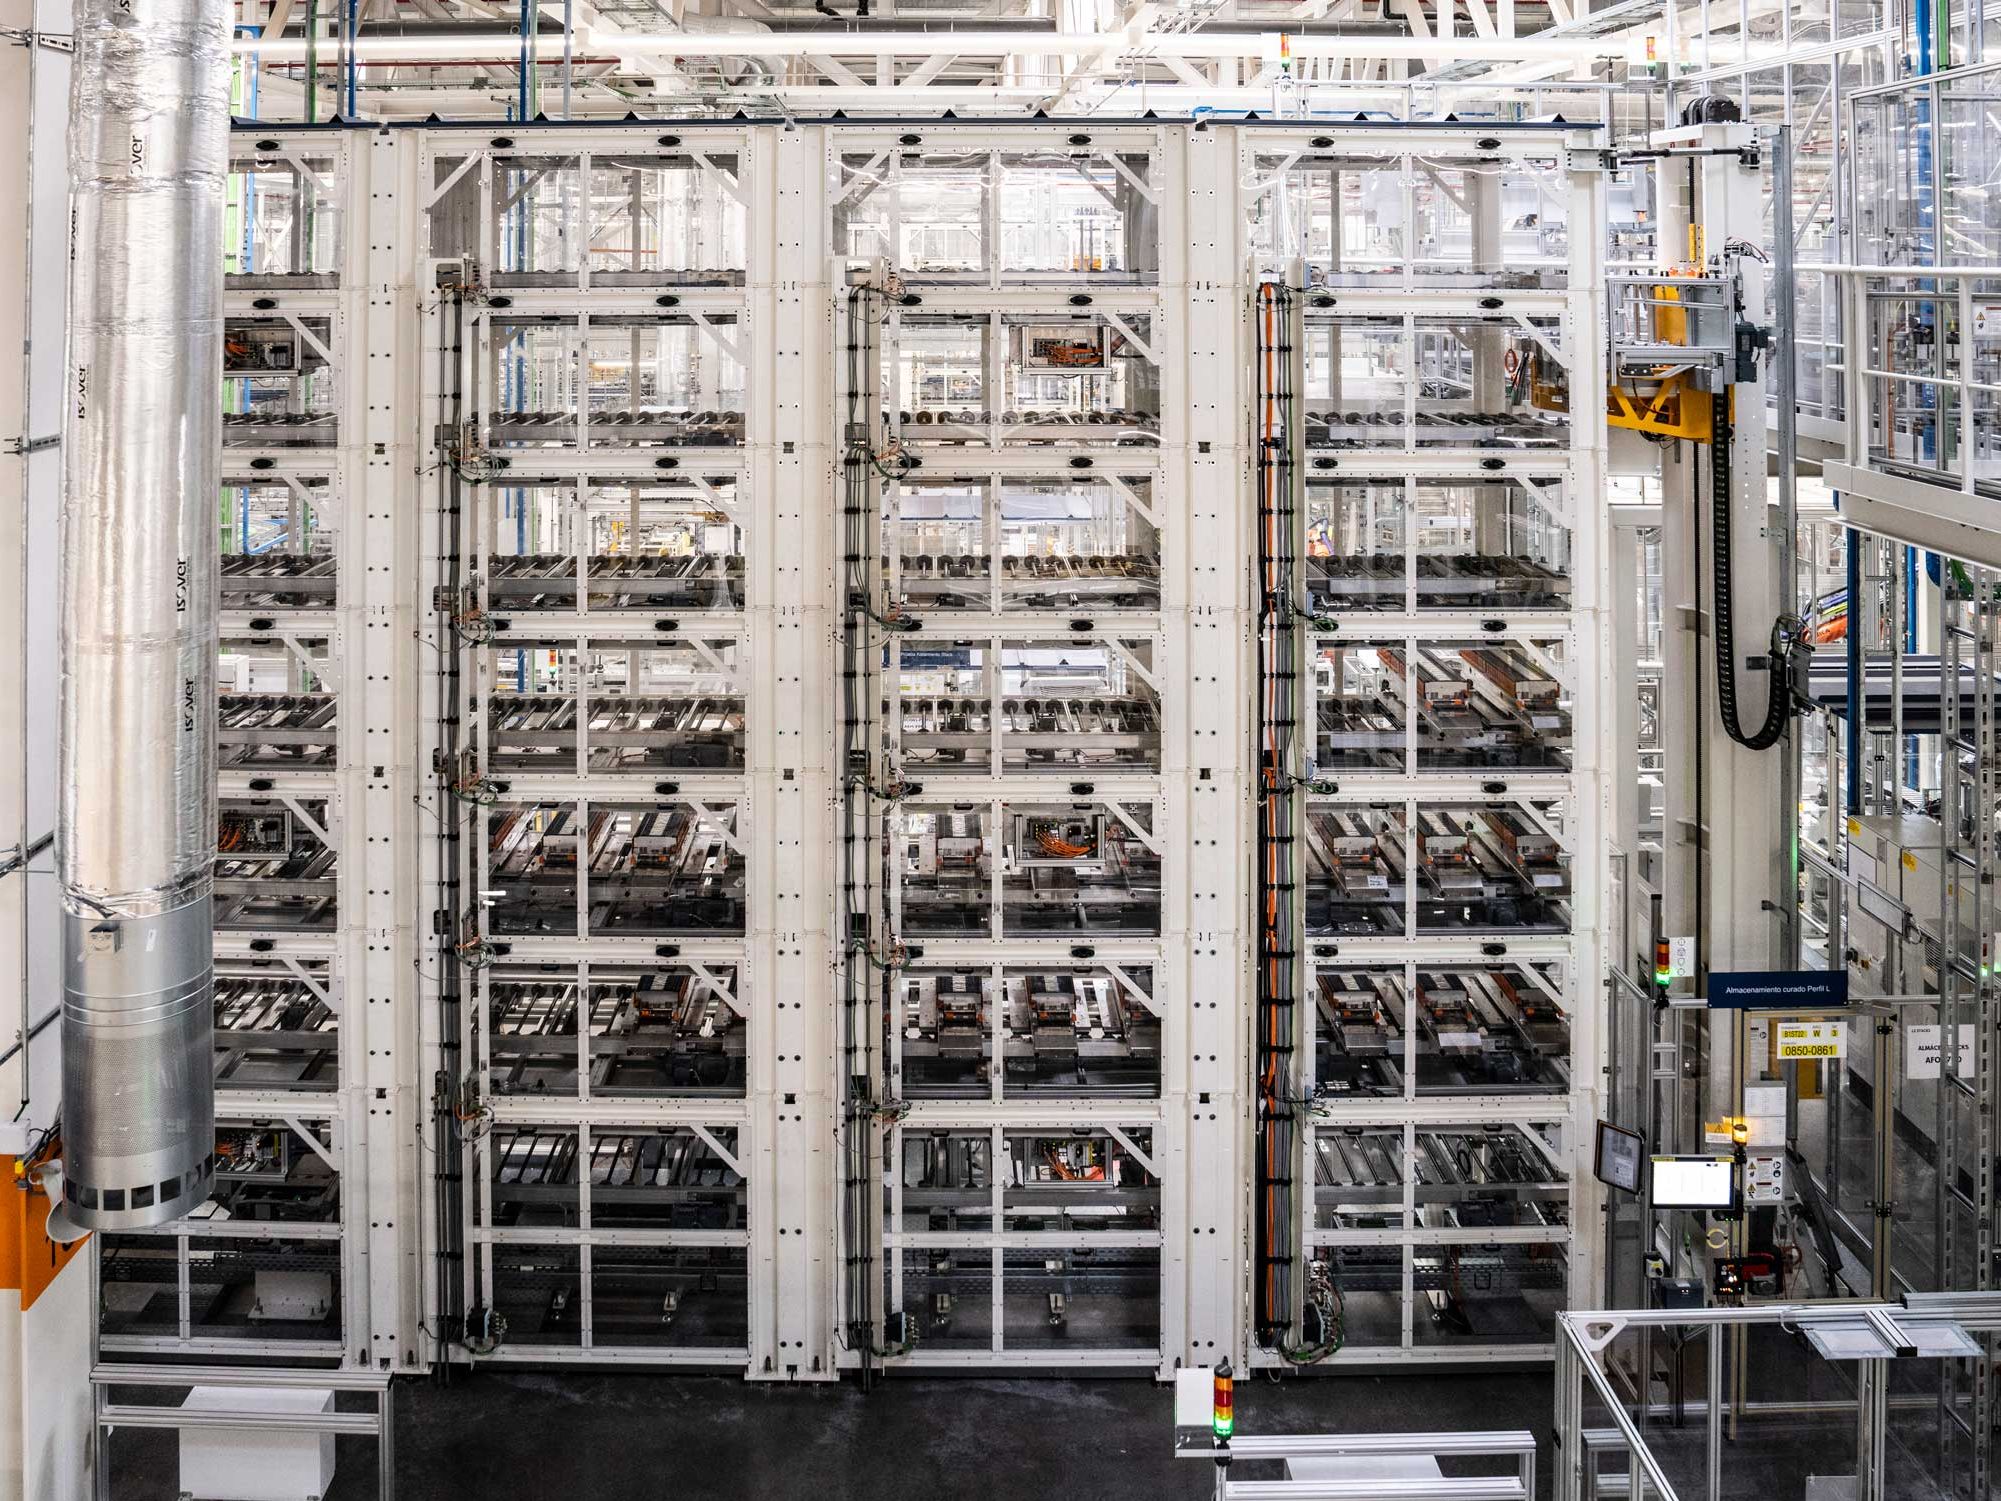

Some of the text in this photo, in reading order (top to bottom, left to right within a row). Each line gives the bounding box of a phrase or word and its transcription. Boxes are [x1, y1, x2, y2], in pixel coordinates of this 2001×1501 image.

[130, 135, 143, 176] over
[1725, 986, 1781, 994] Almacenamiento
[1783, 985, 1806, 993] curado
[1785, 1045, 1833, 1056] 0850-0861
